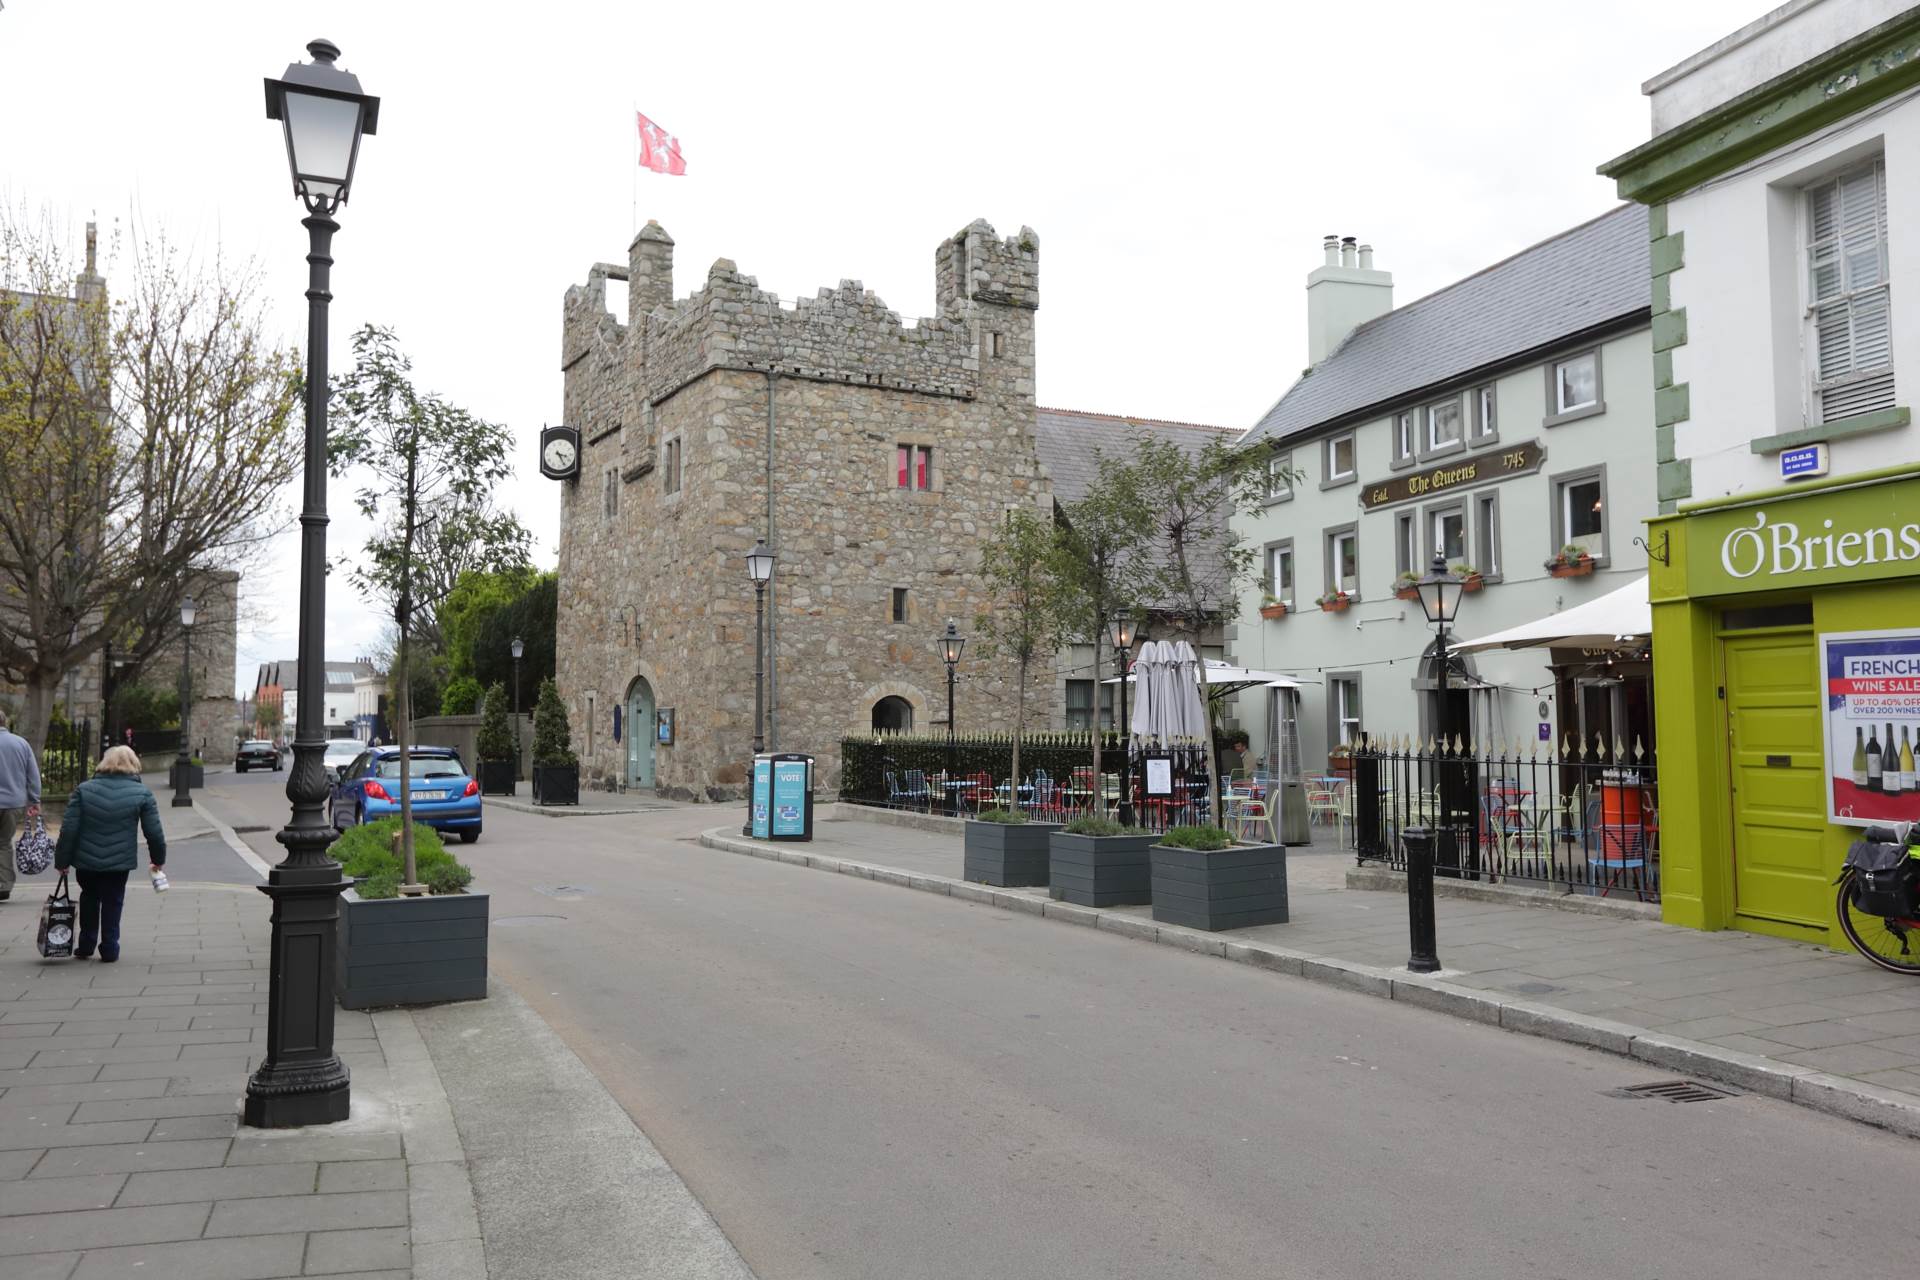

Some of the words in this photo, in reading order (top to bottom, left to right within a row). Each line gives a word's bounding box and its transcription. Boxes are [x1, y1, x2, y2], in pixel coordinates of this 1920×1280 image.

[1408, 477, 1430, 495] The
[1432, 463, 1477, 488] Queens
[1503, 451, 1524, 468] 1745
[1851, 659, 1920, 676] FRENCH
[1852, 680, 1886, 692] WINE
[1889, 679, 1920, 692] SALE
[1853, 698, 1865, 706] UP
[1868, 698, 1879, 706] TO
[1881, 698, 1901, 706] 40%
[1853, 706, 1876, 714] OVER
[1877, 706, 1894, 714] 200
[1895, 706, 1920, 714] WINES
[780, 774, 800, 782] VOTE
